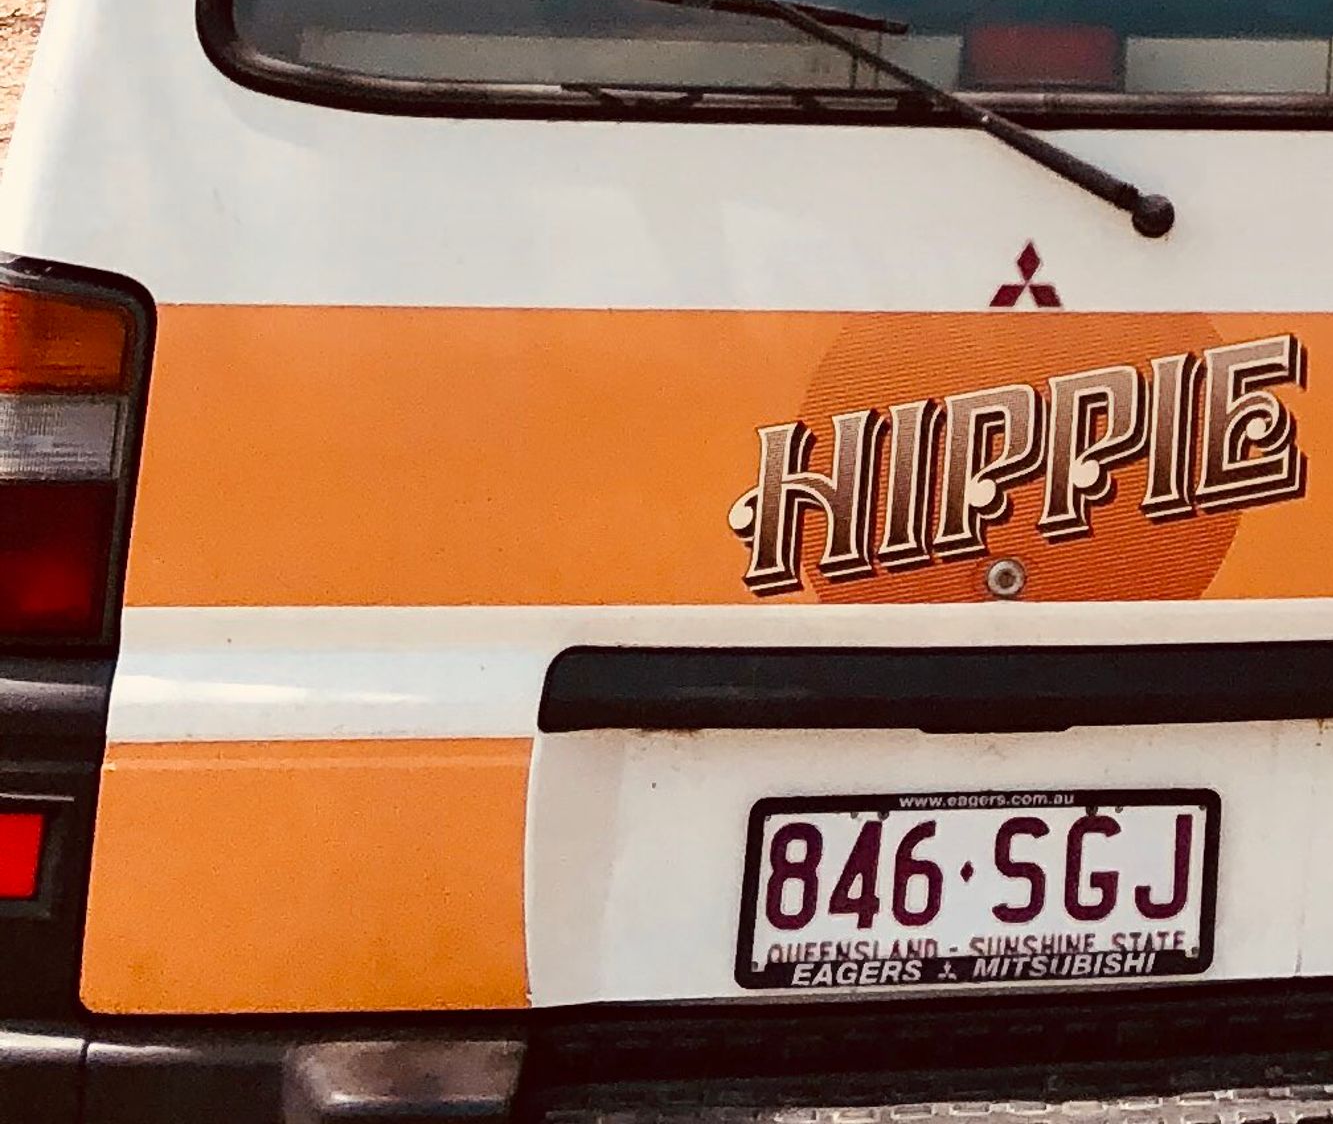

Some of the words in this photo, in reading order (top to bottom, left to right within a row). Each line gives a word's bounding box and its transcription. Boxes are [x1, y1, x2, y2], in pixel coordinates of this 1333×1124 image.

[728, 333, 1308, 596] HIPPIE
[899, 793, 1075, 808] www.eagers.com.au
[767, 938, 938, 964] QUEENSLAND
[969, 933, 1096, 956] SUNSHINE
[1111, 931, 1186, 951] STATE
[791, 959, 923, 986] EAGERS
[972, 952, 1157, 978] MITSUBISHI
